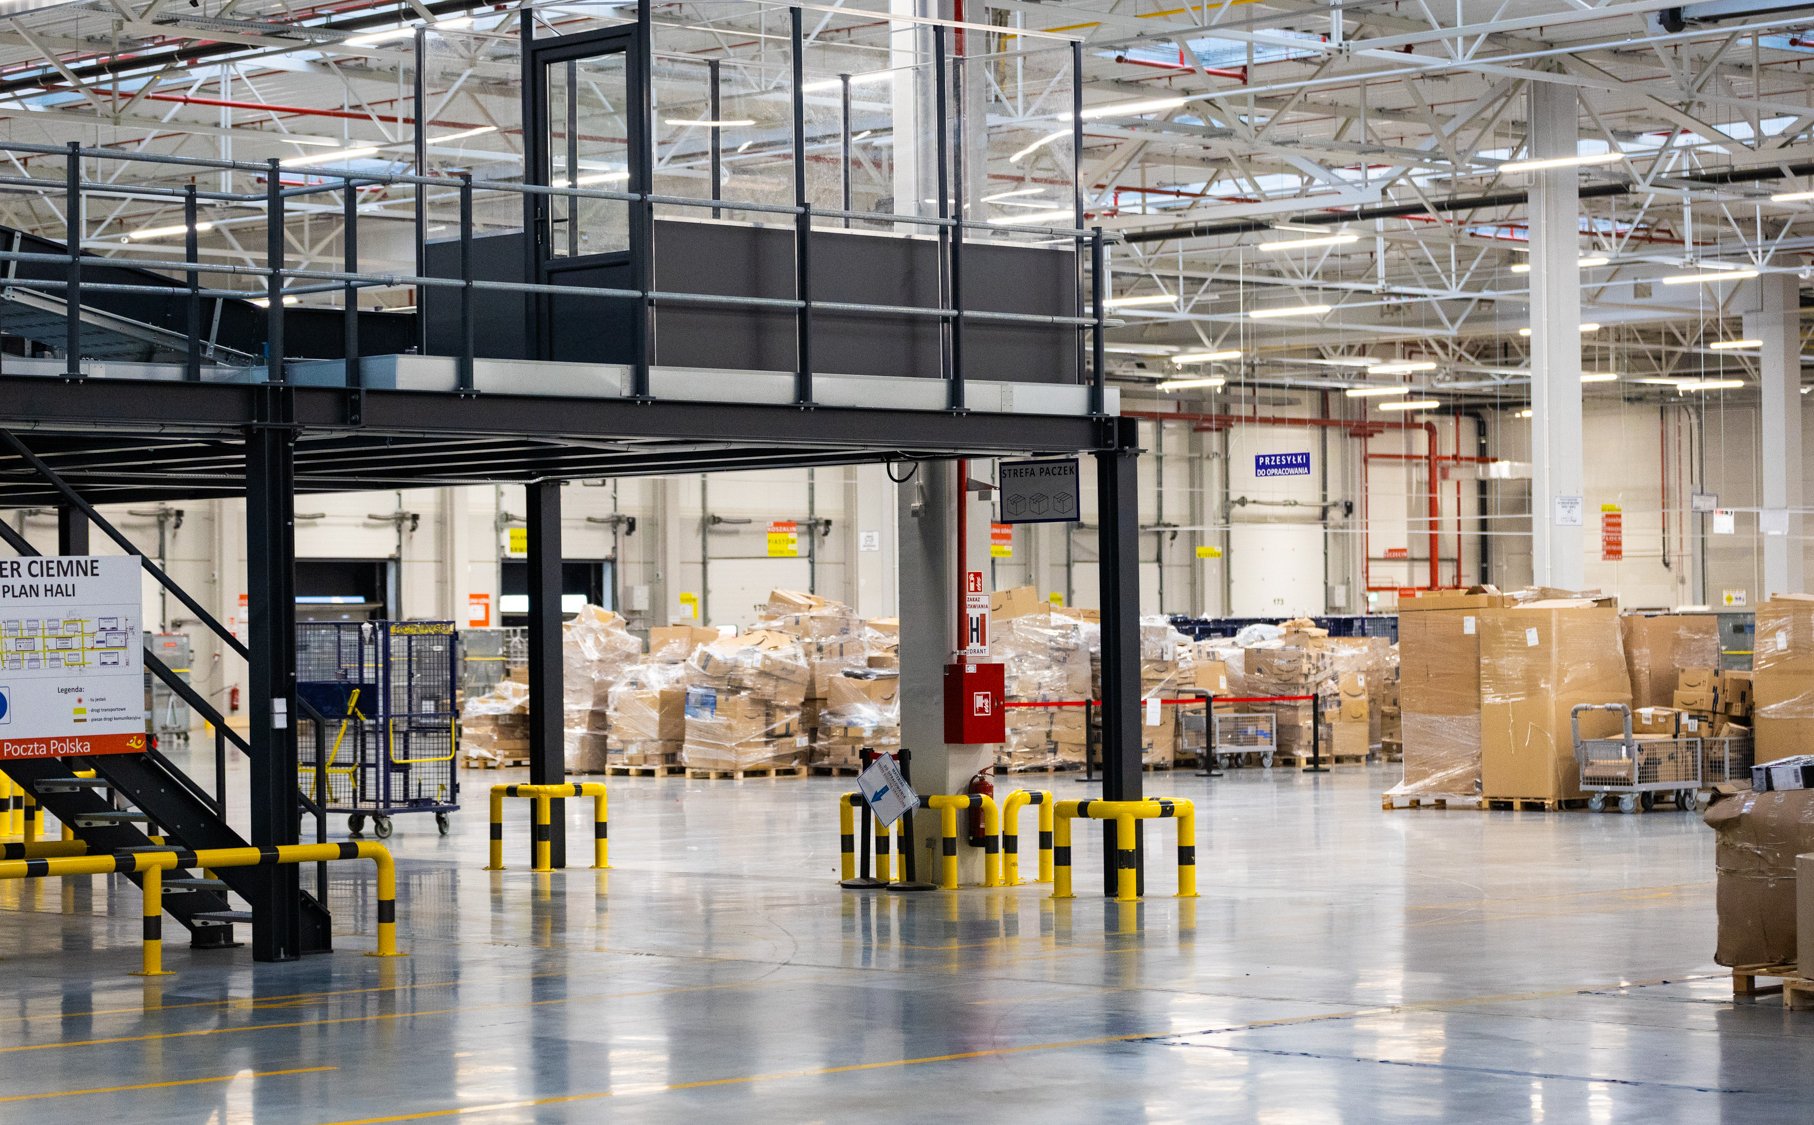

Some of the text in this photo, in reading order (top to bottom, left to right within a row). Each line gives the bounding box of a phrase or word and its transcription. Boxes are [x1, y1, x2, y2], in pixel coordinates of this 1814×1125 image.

[1259, 455, 1306, 465] PRZESYŁKI
[1002, 465, 1075, 479] STREFA PACZEK
[1266, 467, 1308, 476] OPRACOWANIA
[0, 560, 99, 578] ER CIEMNE
[2, 584, 75, 598] PLAN HALI
[970, 616, 979, 643] H
[57, 686, 85, 694] Legenda:
[4, 738, 91, 756] Poczta Polska
